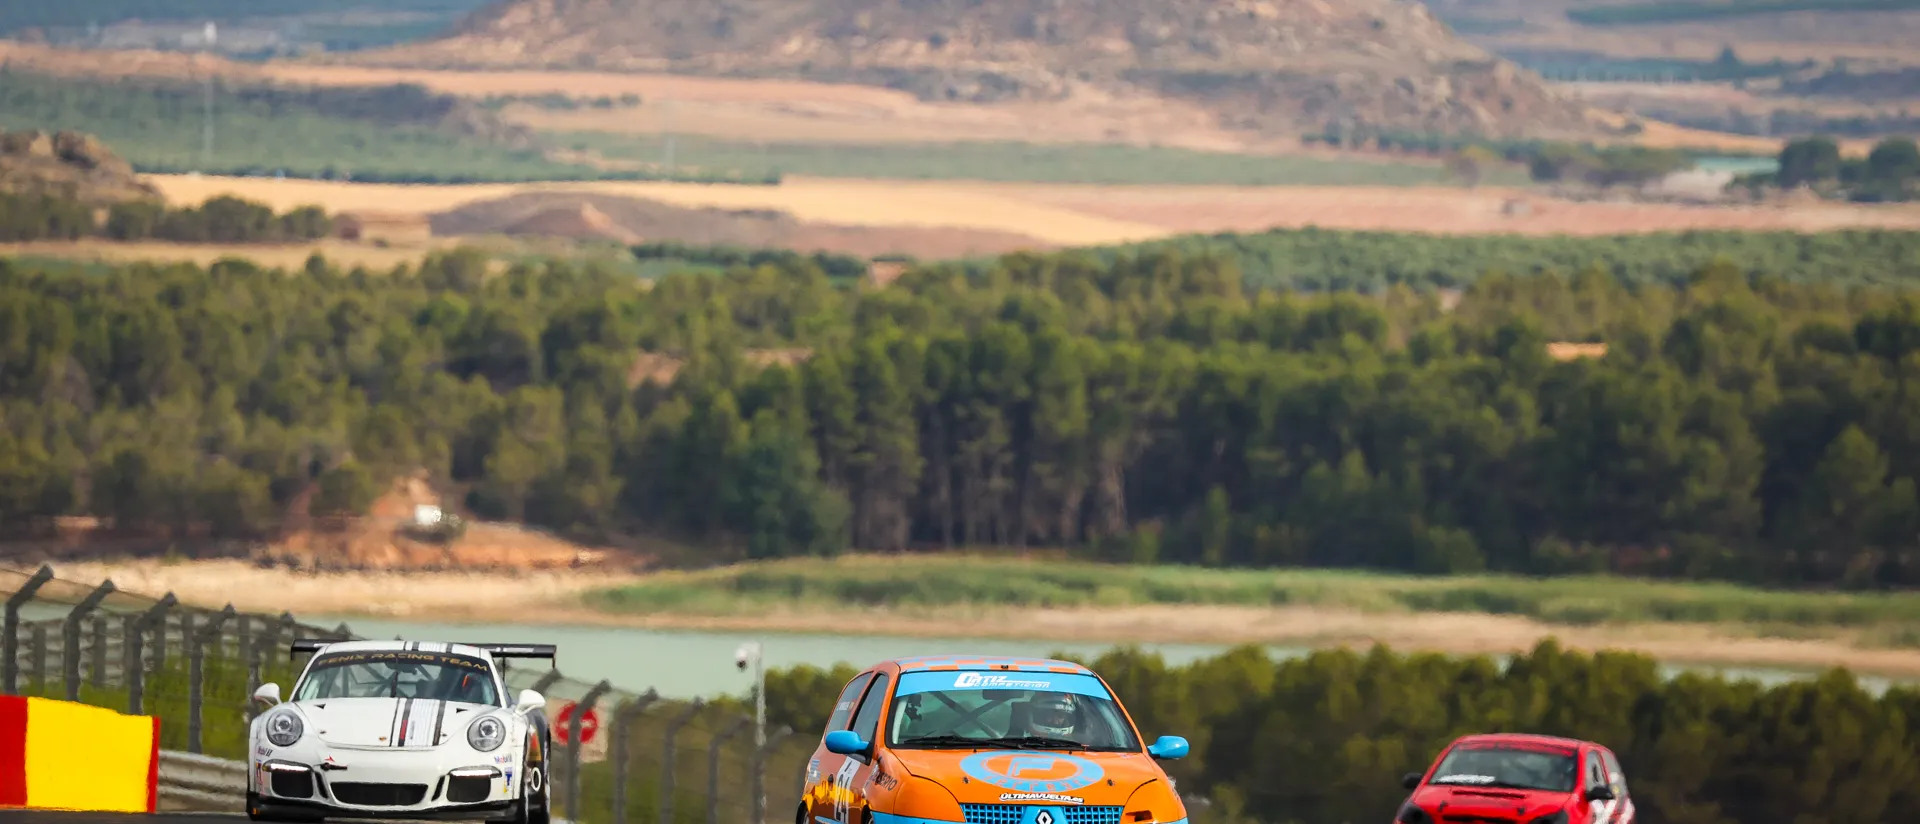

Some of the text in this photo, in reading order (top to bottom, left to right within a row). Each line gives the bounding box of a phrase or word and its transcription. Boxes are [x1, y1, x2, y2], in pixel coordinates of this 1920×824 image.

[318, 653, 488, 671] FENIX RACING TEAM
